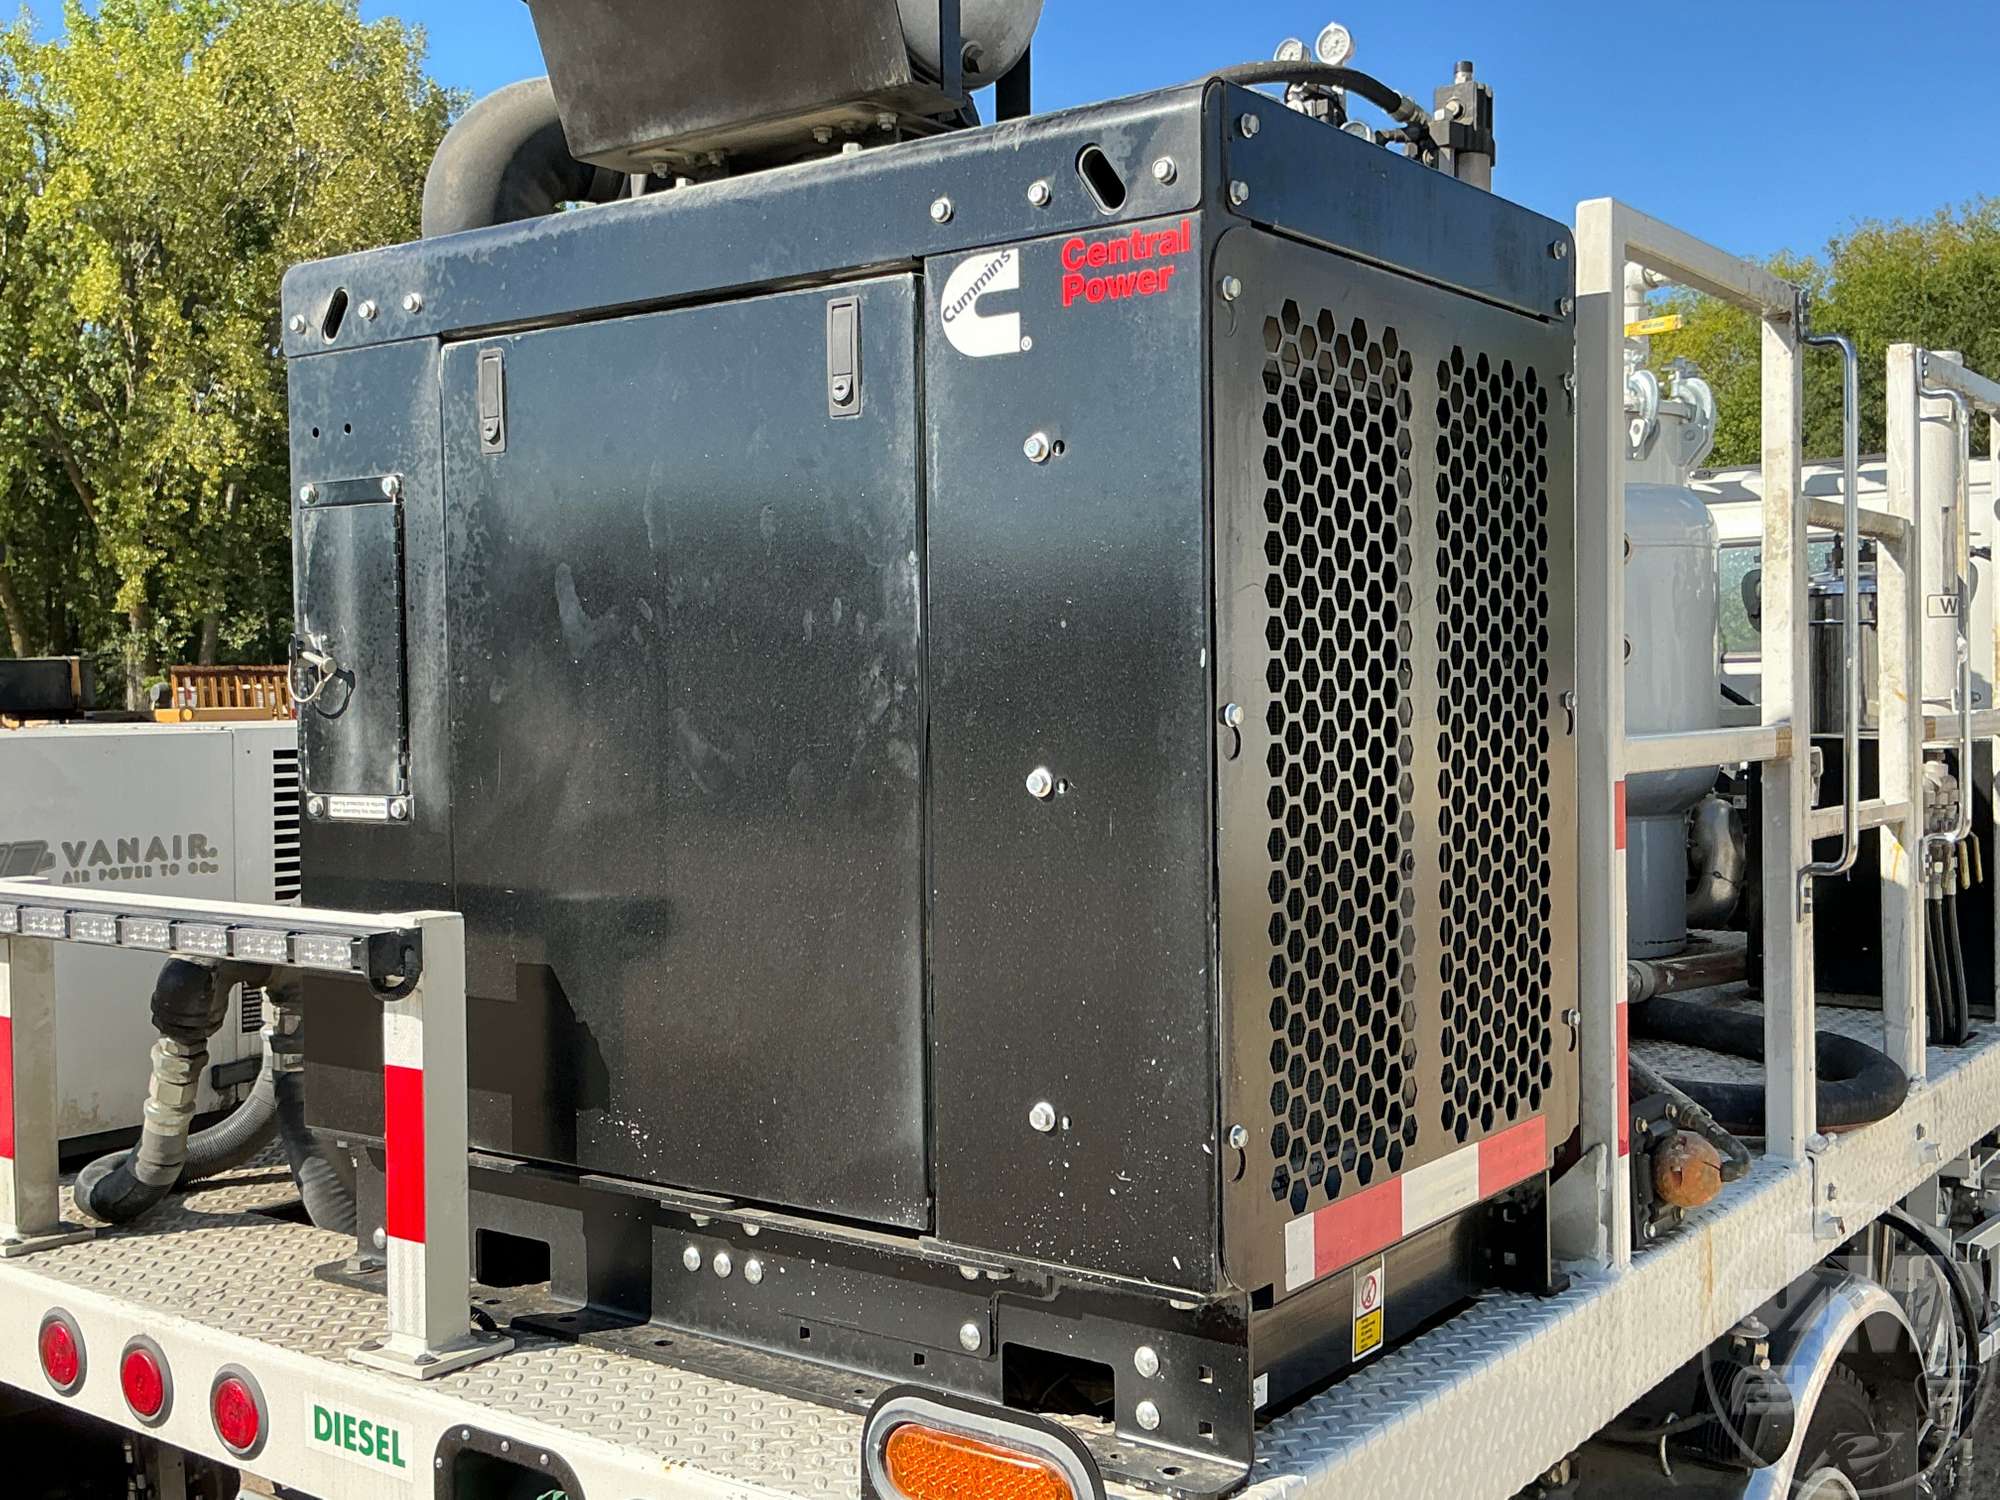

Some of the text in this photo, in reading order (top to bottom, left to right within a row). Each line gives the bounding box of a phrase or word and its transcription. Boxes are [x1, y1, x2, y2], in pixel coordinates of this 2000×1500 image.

[1061, 218, 1192, 272] Central
[942, 249, 1011, 323] Cummins
[1062, 264, 1175, 308] Power
[313, 1404, 406, 1469] DIESEL
